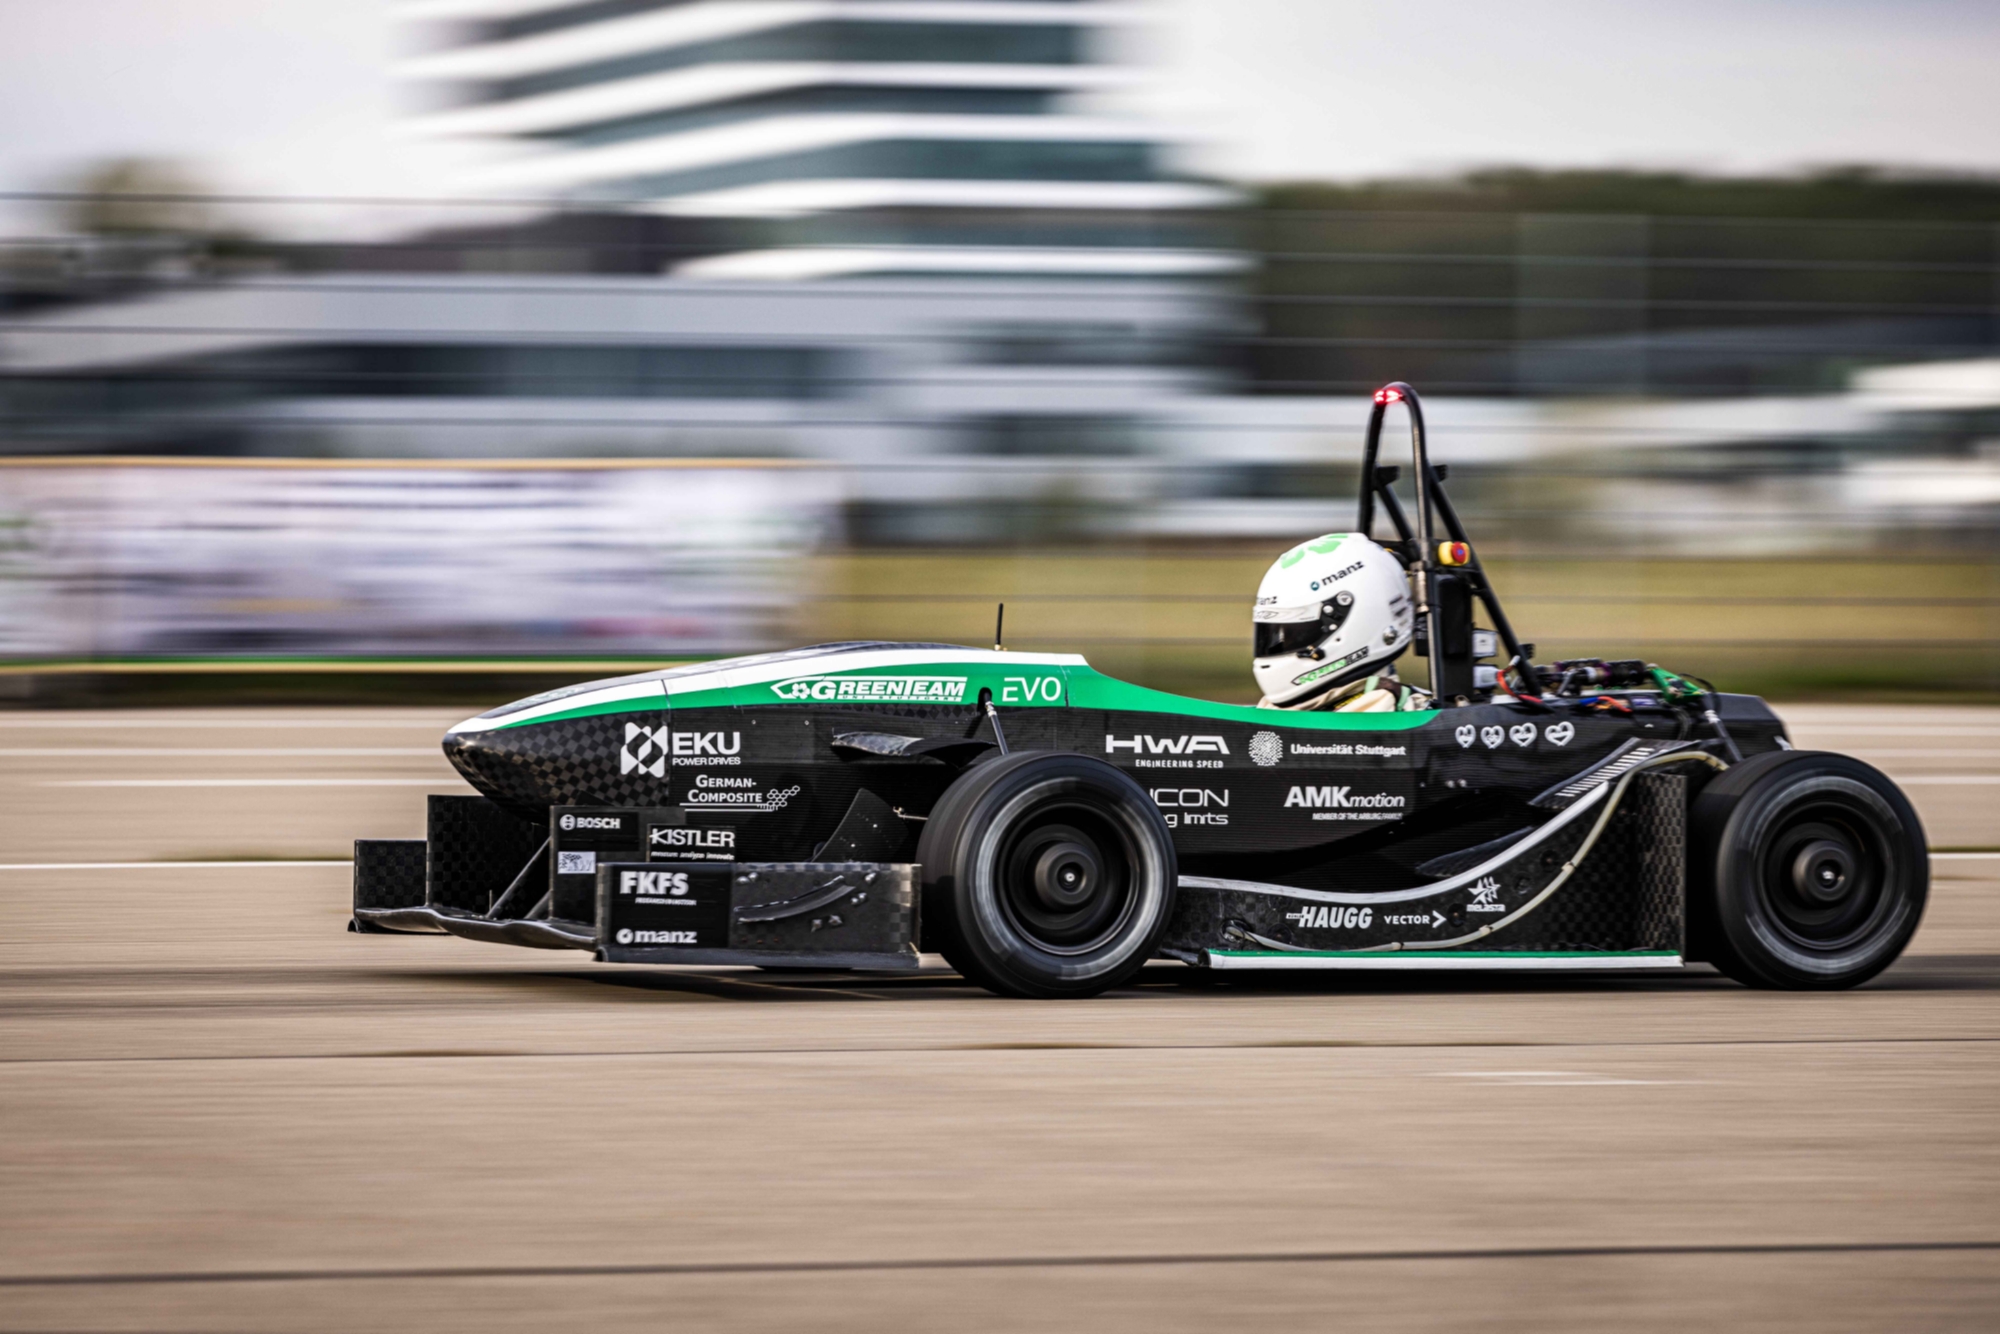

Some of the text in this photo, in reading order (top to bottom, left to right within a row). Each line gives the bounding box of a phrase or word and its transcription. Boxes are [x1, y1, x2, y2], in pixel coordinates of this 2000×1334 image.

[1322, 561, 1365, 586] manz
[1256, 596, 1278, 606] anz
[811, 676, 967, 700] GREENTEAM
[1002, 677, 1062, 702] EVO
[672, 732, 741, 755] EKU
[1105, 735, 1231, 754] HWA
[1290, 743, 1407, 757] Universität Stuttgart
[672, 757, 741, 766] POWER DRIVES
[1135, 759, 1223, 768] ENGINEERING SPEED
[695, 774, 757, 788] GERMAN-
[687, 789, 763, 803] COMPOSITE
[576, 817, 621, 830] BOSCH
[649, 828, 736, 848] KISTLER
[619, 871, 690, 896] FKFS
[1298, 906, 1374, 930] HAUGG
[1383, 915, 1431, 925] VECTOR
[633, 930, 698, 944] manz
